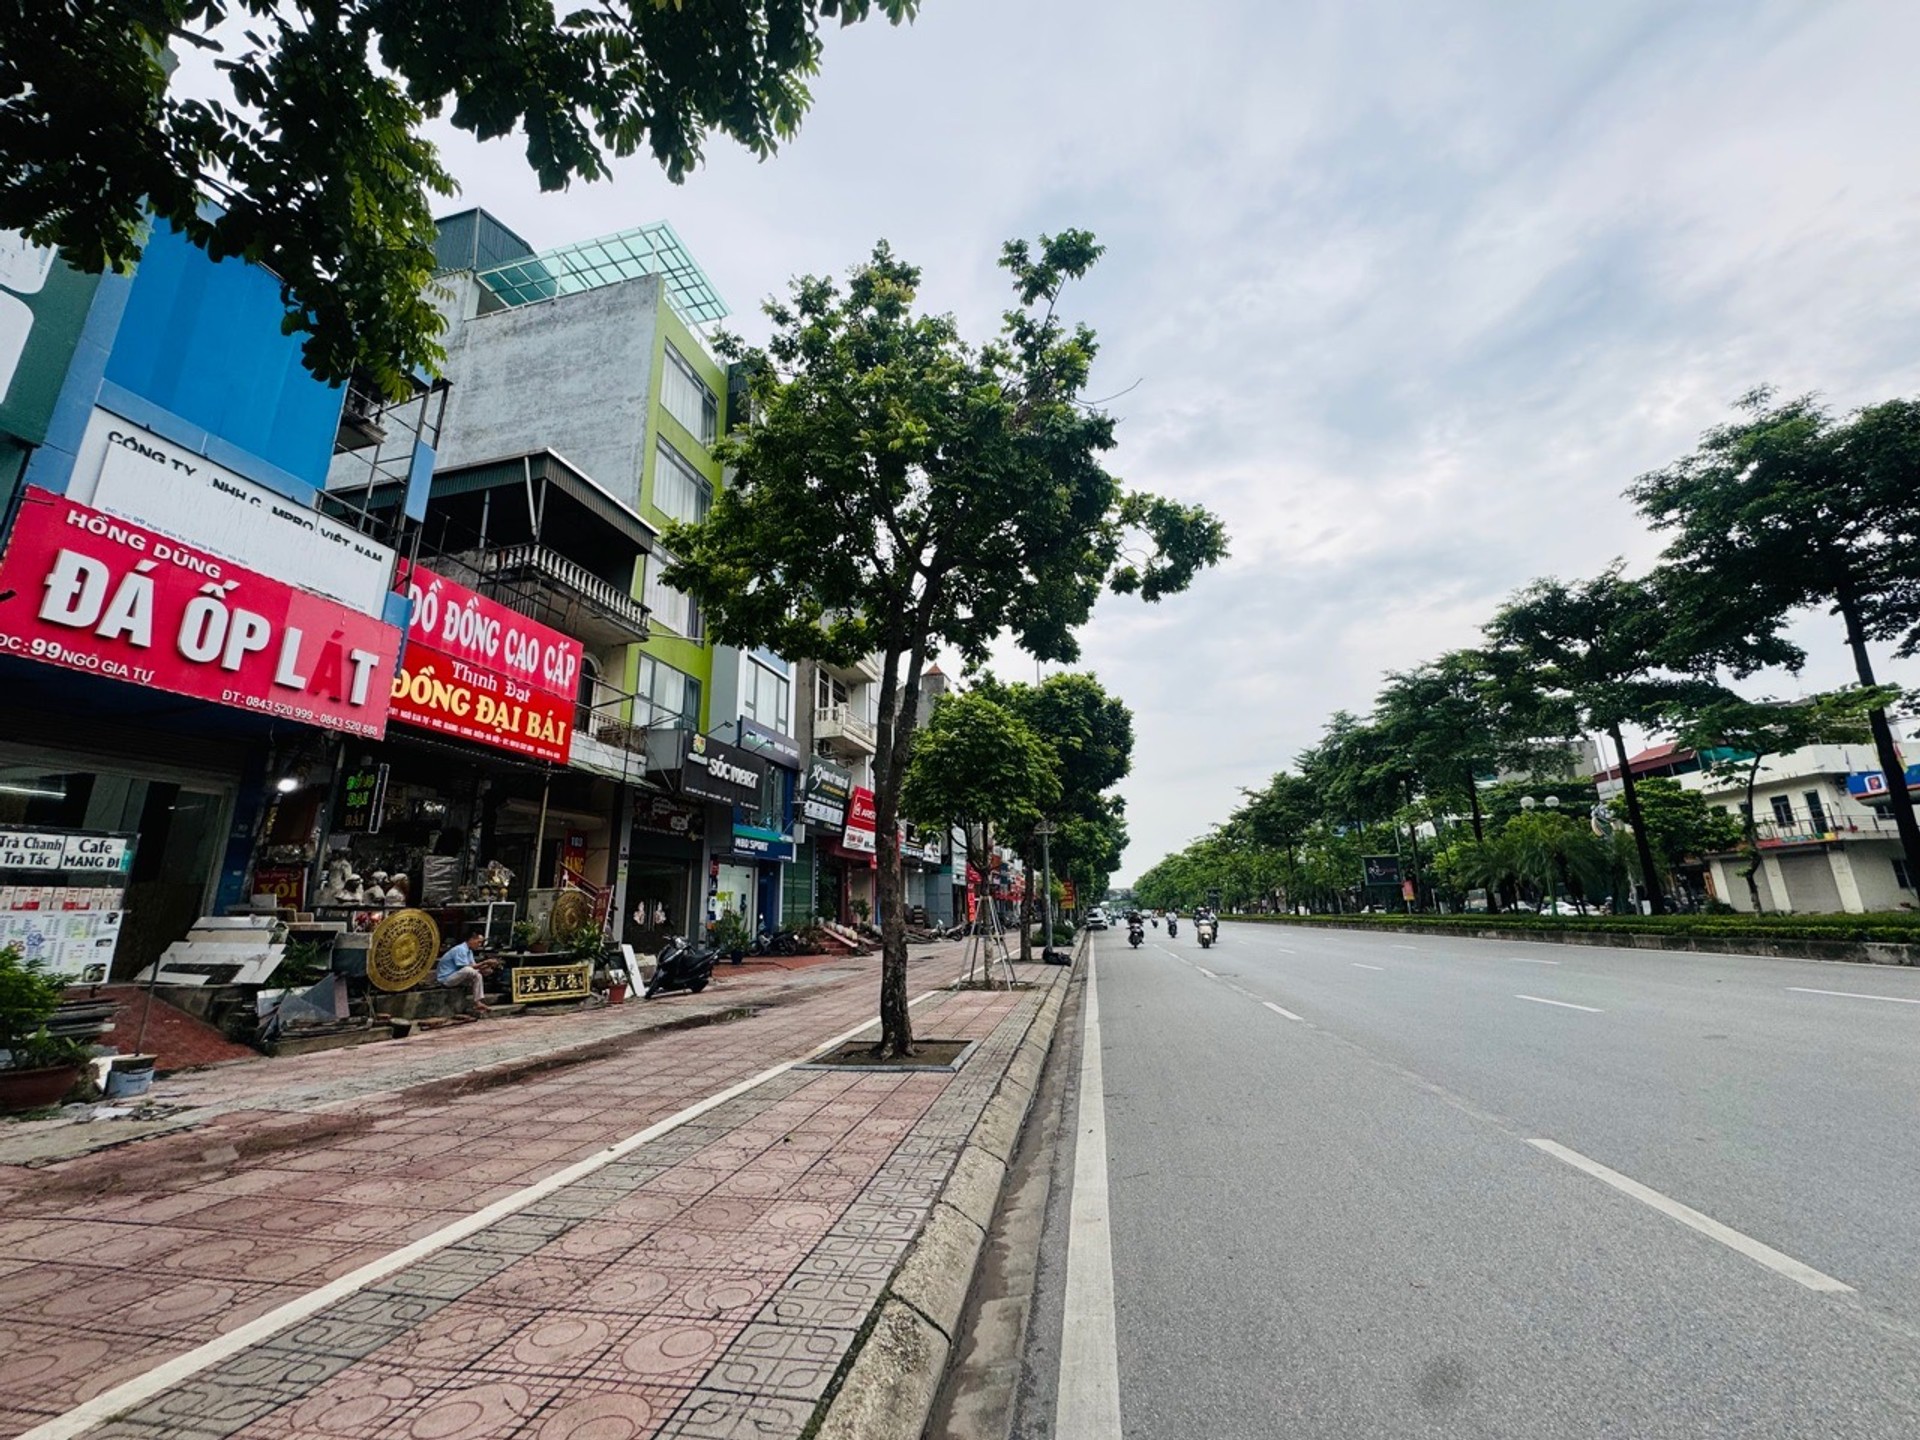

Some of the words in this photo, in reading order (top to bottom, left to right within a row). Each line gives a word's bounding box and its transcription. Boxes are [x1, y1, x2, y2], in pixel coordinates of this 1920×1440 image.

[108, 430, 166, 465] CÔNG
[66, 509, 146, 552] HỒNG
[153, 543, 222, 579] DŨNG
[38, 548, 159, 648] ĐÁ
[177, 580, 272, 671] ỐP
[274, 626, 380, 706] LÁT
[442, 596, 501, 658] ĐỒNG
[504, 628, 539, 674] CAO
[543, 641, 576, 688] CẤP
[30, 637, 61, 660] 99
[101, 659, 129, 677] GIA
[133, 667, 155, 684] TỰ
[451, 660, 498, 693] Thịnh
[504, 680, 531, 703] Đạt
[246, 695, 273, 712] 0843
[274, 701, 292, 715] 520
[294, 706, 313, 720] 999
[391, 665, 471, 717] ĐỒNG
[474, 694, 522, 733] ĐẠI
[525, 709, 567, 746] BÁI
[0, 835, 19, 849] Trà
[24, 837, 62, 851] Chanh
[4, 851, 26, 865] Trà
[63, 855, 104, 868] MANG
[107, 857, 120, 868] ĐI
[79, 839, 113, 854] Cafe
